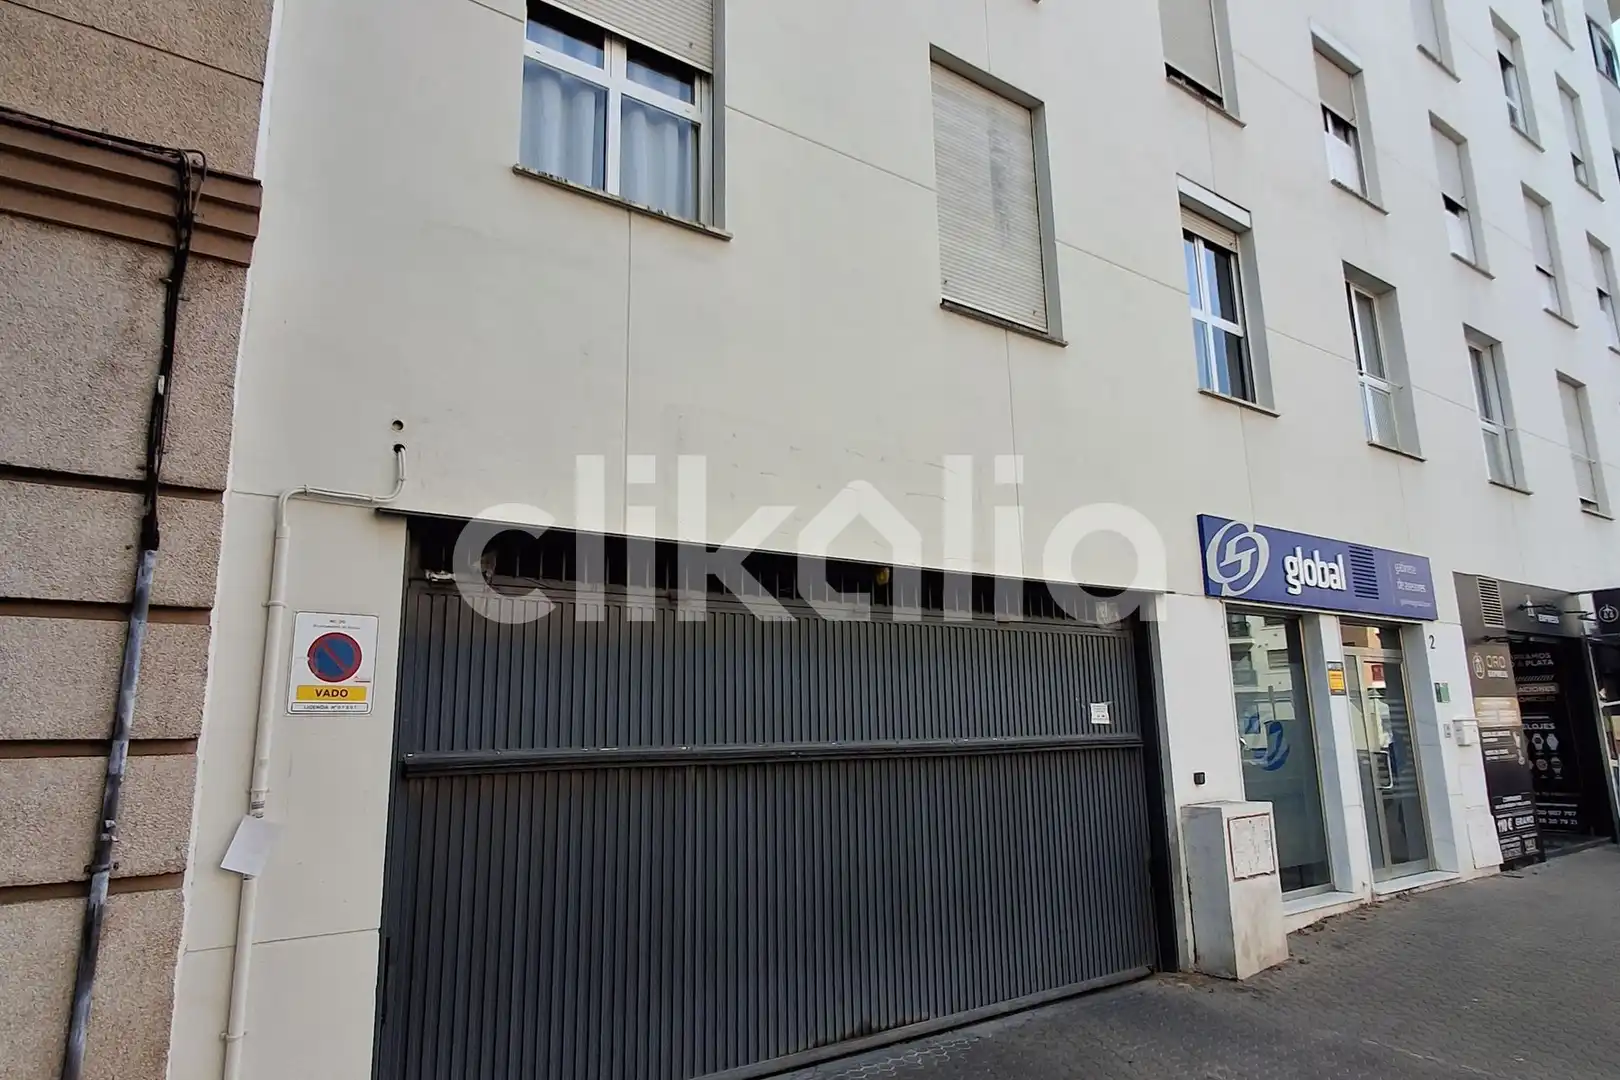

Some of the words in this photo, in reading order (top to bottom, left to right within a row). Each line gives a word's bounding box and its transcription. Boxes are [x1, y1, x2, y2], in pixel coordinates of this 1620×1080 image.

[1285, 546, 1347, 595] global
[1428, 634, 1436, 650] 2
[1486, 655, 1506, 669] ORO
[315, 689, 348, 698] VADO
